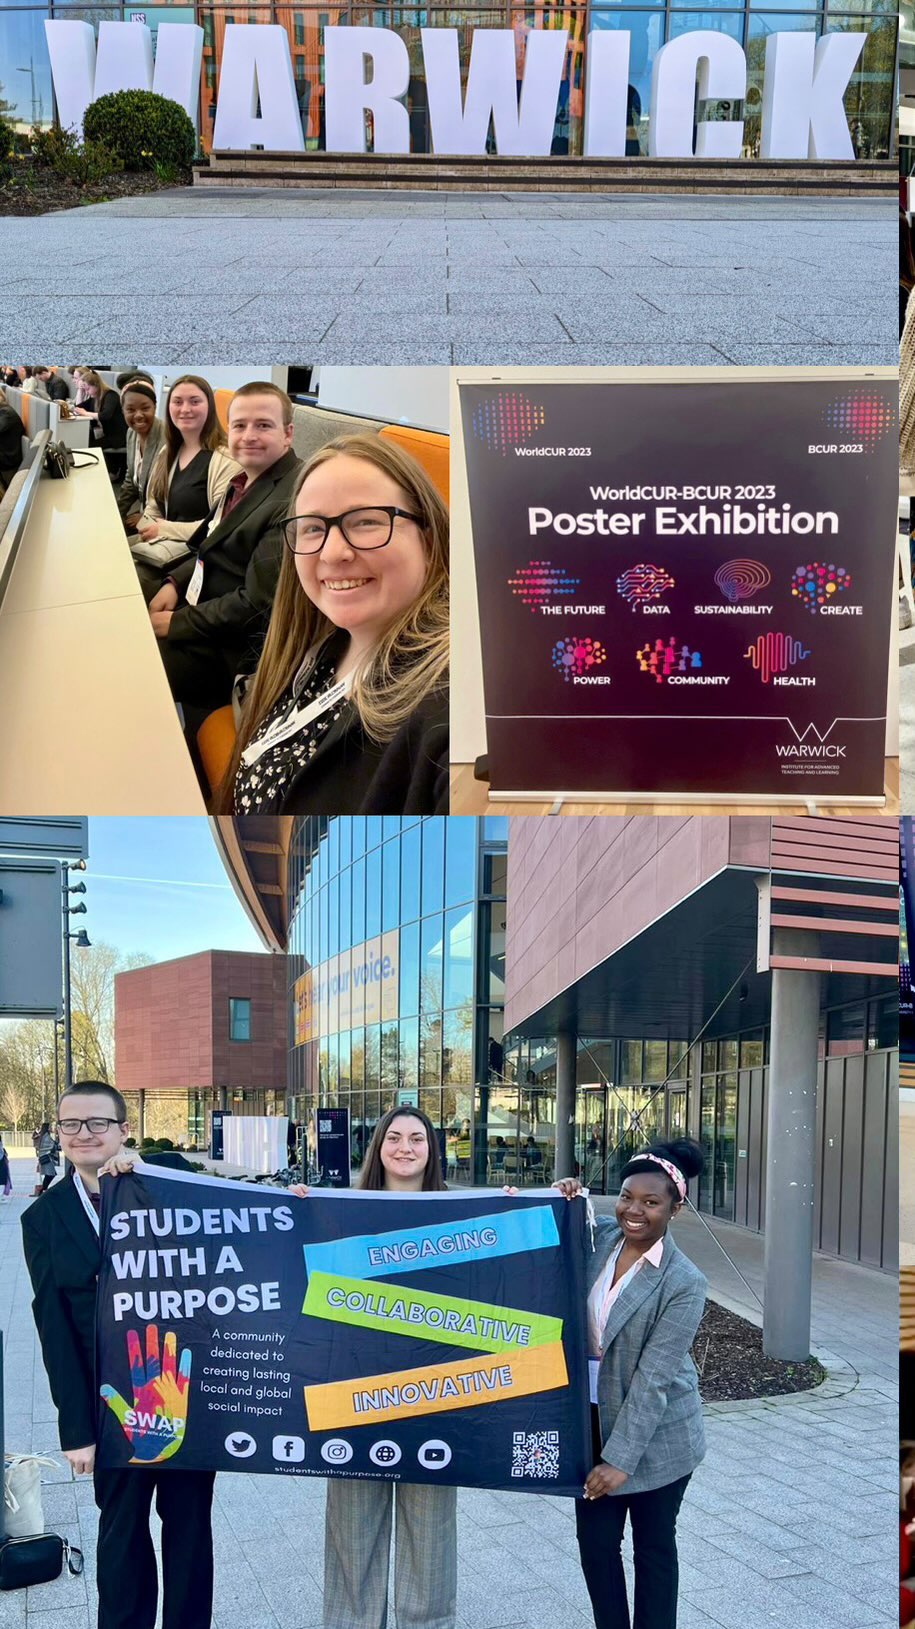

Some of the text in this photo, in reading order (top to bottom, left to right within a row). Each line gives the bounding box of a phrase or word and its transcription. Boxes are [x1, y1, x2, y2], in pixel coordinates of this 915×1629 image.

[44, 19, 869, 160] WARWICK
[514, 447, 591, 456] WorldCUR 2023
[808, 444, 863, 454] BCUR 2023
[589, 486, 775, 501] WorldCUR-BCUR 2023
[528, 504, 839, 535] Poster Exhibition
[541, 606, 605, 614] THE FUTURE
[643, 606, 670, 614] DATA
[694, 606, 773, 614] SUSTAINABILITY
[820, 606, 863, 614] CREATE
[573, 676, 611, 685] POWER
[667, 676, 730, 685] COMMUNITY
[773, 677, 816, 686] HEALTH
[775, 745, 847, 757] WARWICK
[353, 952, 395, 987] voice.
[110, 1206, 295, 1241] STUDENTS
[368, 1228, 497, 1265] ENGAGING
[112, 1246, 244, 1280] WITH A
[113, 1281, 281, 1321] PURPOSE
[326, 1287, 531, 1346] COLLABORATIVE
[212, 1328, 285, 1345] A community
[210, 1346, 285, 1361] dedicated to
[203, 1367, 290, 1383] creating lasting
[200, 1381, 292, 1400] local and global
[352, 1364, 513, 1413] INNOVATIVE
[208, 1402, 282, 1416] social impact
[124, 1410, 184, 1432] SWAP
